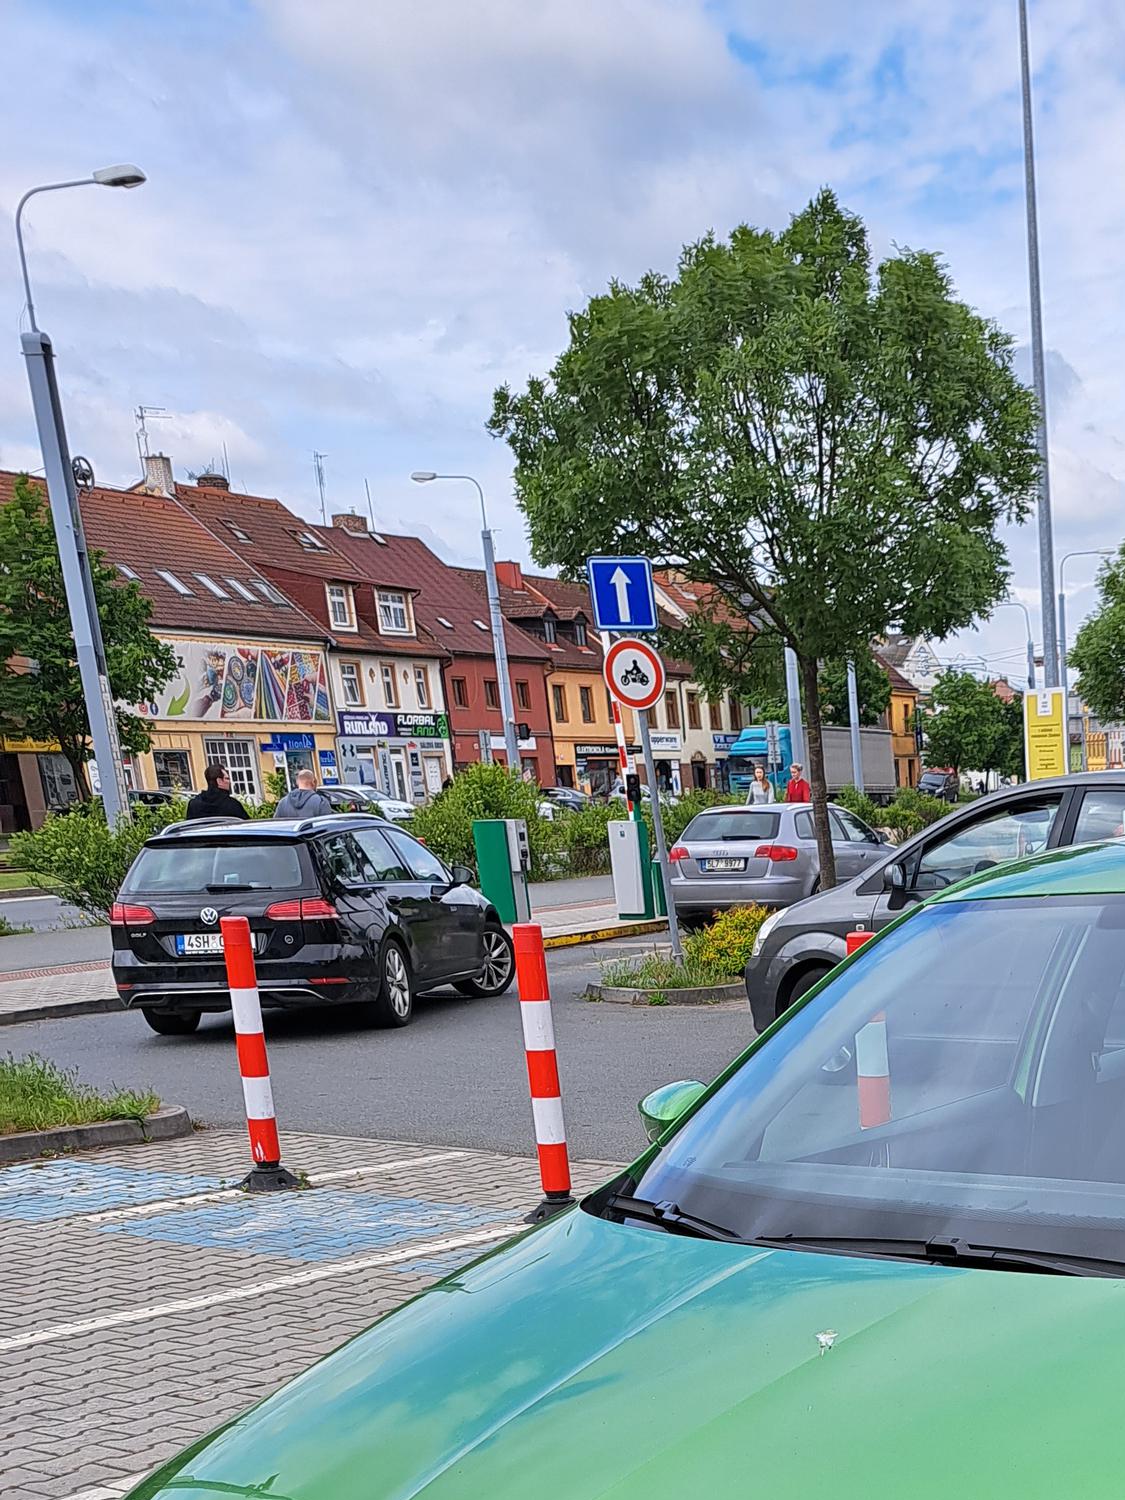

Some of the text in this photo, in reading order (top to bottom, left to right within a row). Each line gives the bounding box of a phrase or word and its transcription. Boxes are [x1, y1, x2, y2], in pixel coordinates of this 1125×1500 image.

[397, 715, 436, 726] FLORBAL
[651, 736, 678, 745] upperware
[187, 935, 210, 949] 4SH
